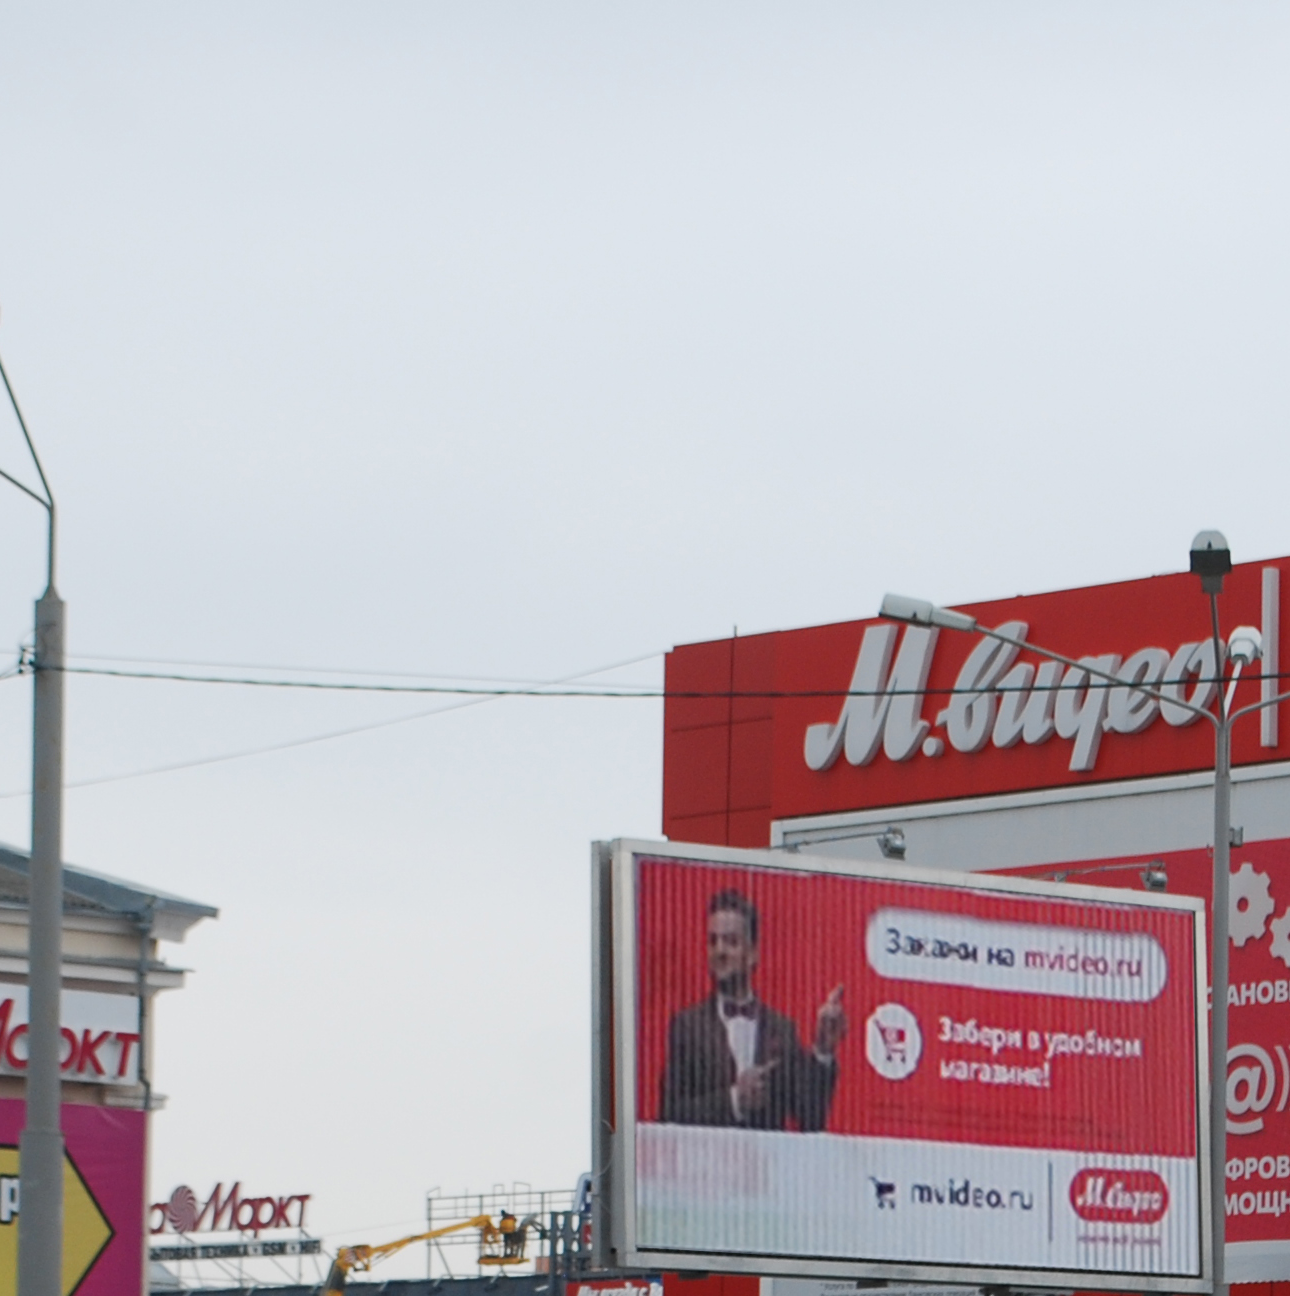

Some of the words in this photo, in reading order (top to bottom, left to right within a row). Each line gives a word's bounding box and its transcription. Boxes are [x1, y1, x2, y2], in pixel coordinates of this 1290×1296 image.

[804, 620, 1226, 772] М.видео
[987, 948, 1014, 967] на
[1024, 946, 1142, 977] mvideo.ru
[938, 1017, 1022, 1055] Забери
[1027, 1031, 1041, 1050] в
[1044, 1029, 1143, 1060] удобном
[939, 1059, 1051, 1088] магазине!
[911, 1179, 1034, 1210] mvideo.ru
